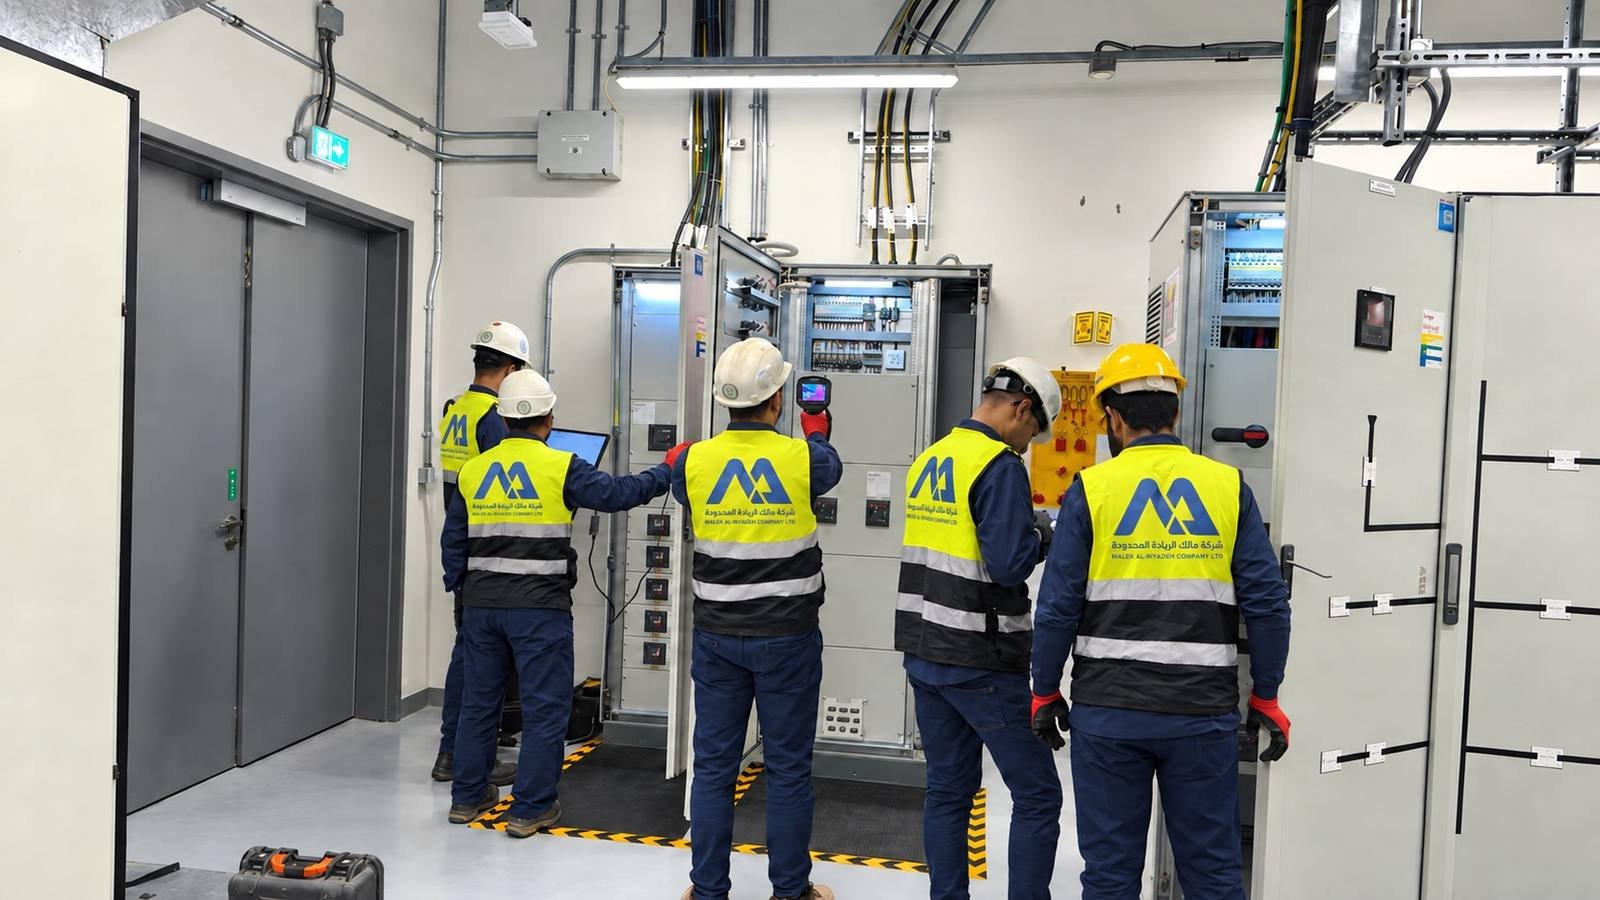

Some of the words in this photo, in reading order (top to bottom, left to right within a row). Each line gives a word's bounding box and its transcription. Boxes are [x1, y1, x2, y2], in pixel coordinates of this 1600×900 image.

[1111, 540, 1150, 551] المحدودة
[1151, 540, 1177, 551] الريادة
[1179, 540, 1199, 549] مالك
[1200, 540, 1224, 551] شركة
